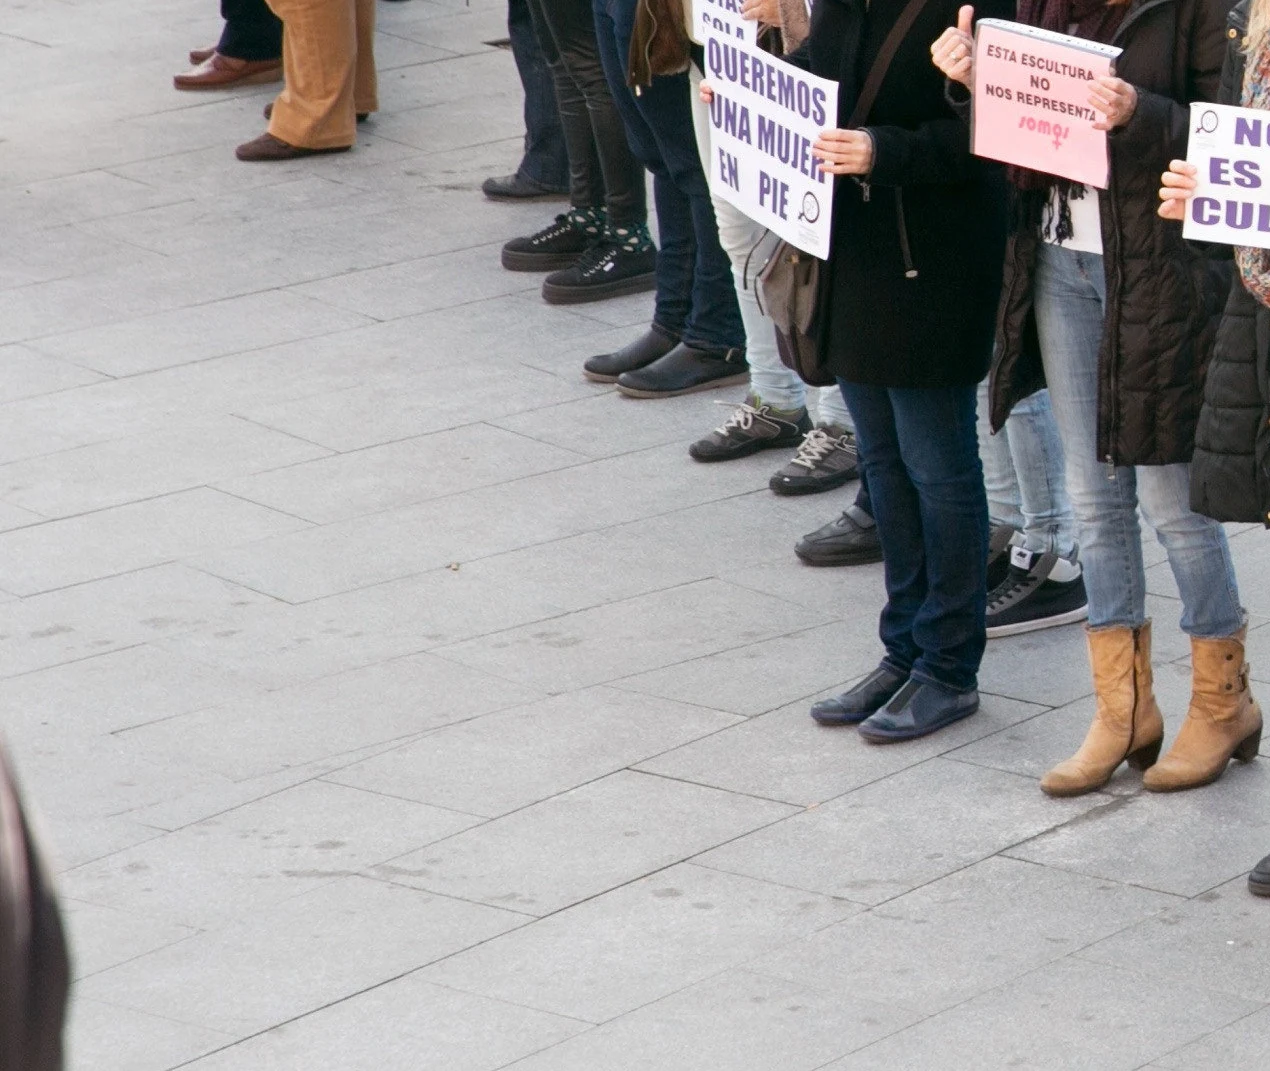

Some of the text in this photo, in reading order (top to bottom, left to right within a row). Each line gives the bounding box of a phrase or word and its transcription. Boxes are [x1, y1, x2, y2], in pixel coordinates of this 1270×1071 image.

[987, 44, 1094, 81] ESTA ESCULTURA
[708, 37, 826, 126] QUEREMOS
[1030, 75, 1051, 91] NO
[711, 92, 752, 145] UNA
[985, 84, 1096, 121] NOS REPRESENTA
[719, 146, 789, 221] EN PIE
[1209, 157, 1262, 189] ES
